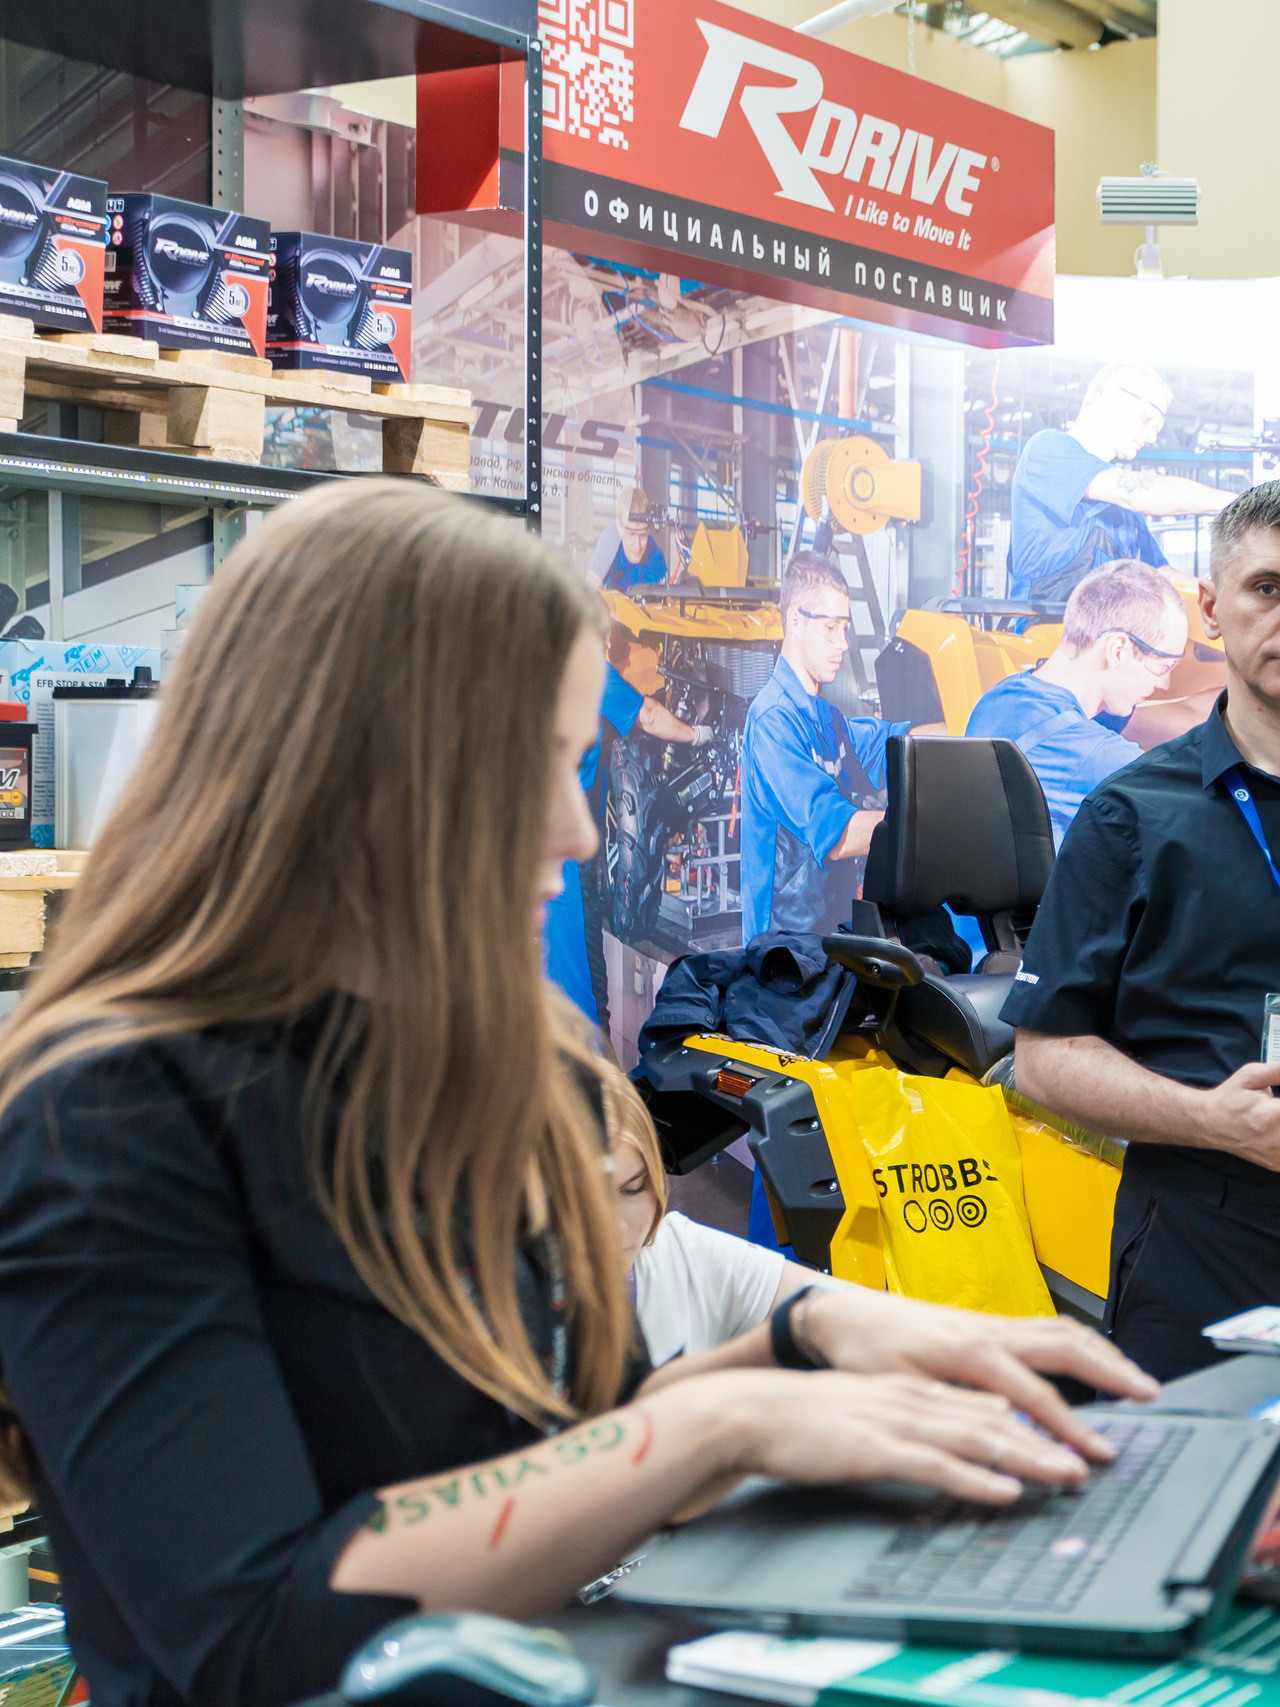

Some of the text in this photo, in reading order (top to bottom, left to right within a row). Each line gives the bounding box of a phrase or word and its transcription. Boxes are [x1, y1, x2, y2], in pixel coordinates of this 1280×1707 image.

[67, 197, 92, 213] AGM
[0, 204, 39, 227] DRIVE
[844, 195, 972, 252] I Like to Move It
[235, 235, 257, 250] AGM
[583, 189, 1009, 322] ОФИЦИАЛЬНЫЙ ПОСТАВЩИК
[61, 256, 69, 271] 5
[380, 266, 400, 280] AGM
[228, 290, 235, 305] 5
[376, 318, 383, 333] 5
[578, 471, 624, 489] область,
[37, 679, 53, 688] EFB
